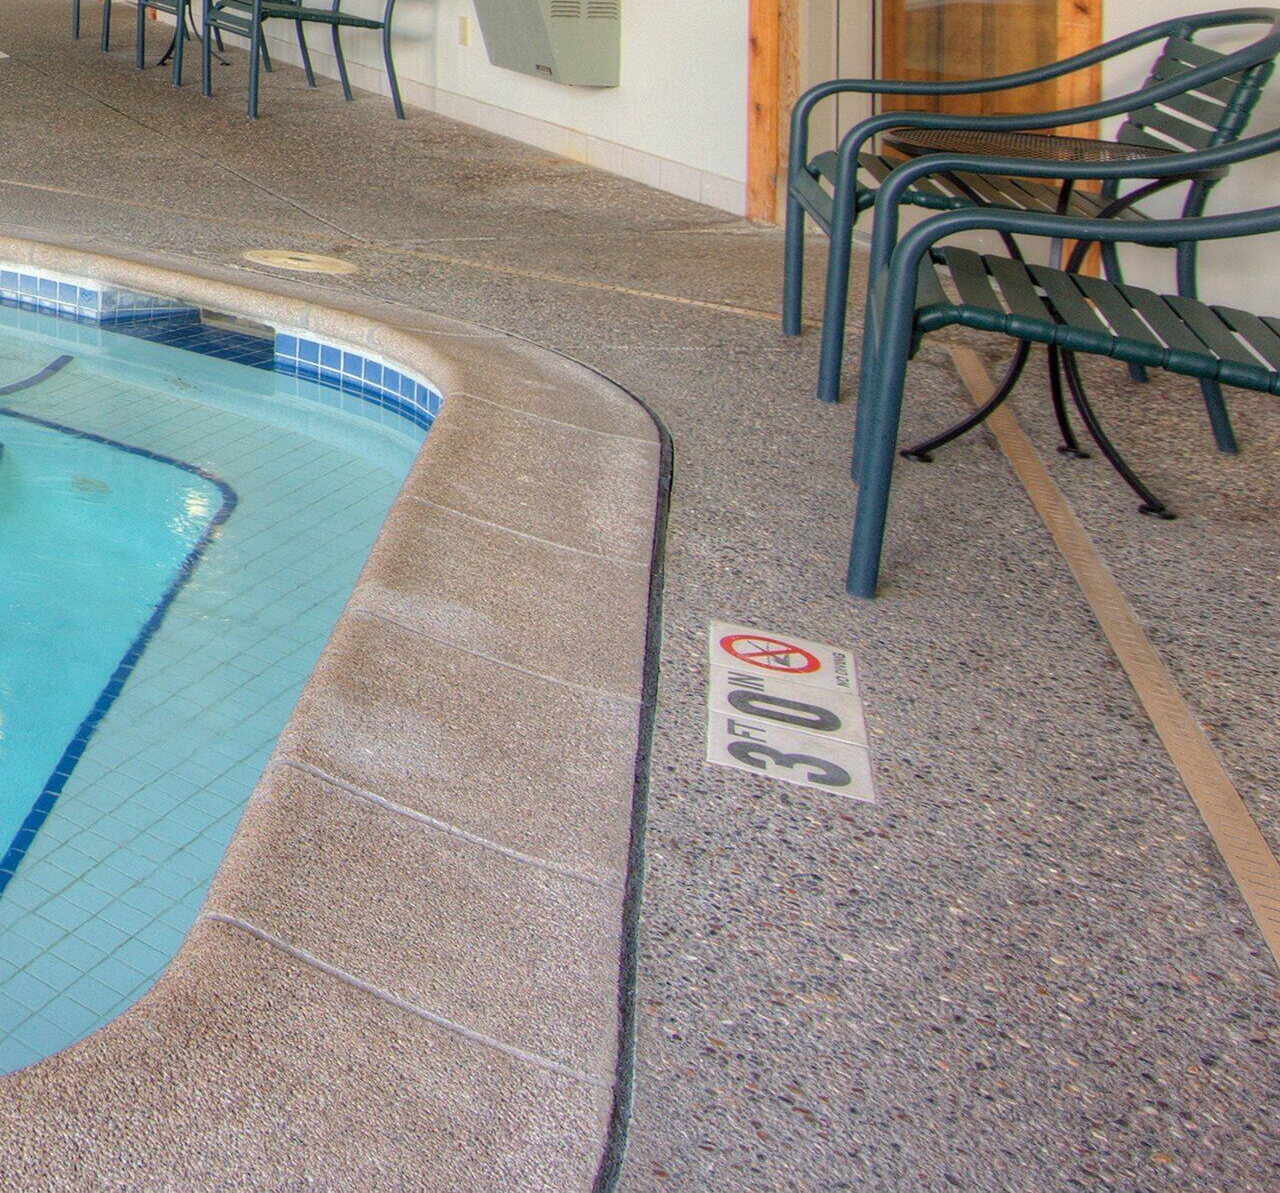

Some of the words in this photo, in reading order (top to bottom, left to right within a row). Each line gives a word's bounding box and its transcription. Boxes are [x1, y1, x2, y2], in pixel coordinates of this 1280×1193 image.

[832, 651, 849, 676] DIVING
[728, 670, 765, 692] IN
[836, 675, 850, 689] NO
[727, 689, 842, 732] 0
[727, 718, 766, 743] FT
[727, 741, 851, 787] 3
